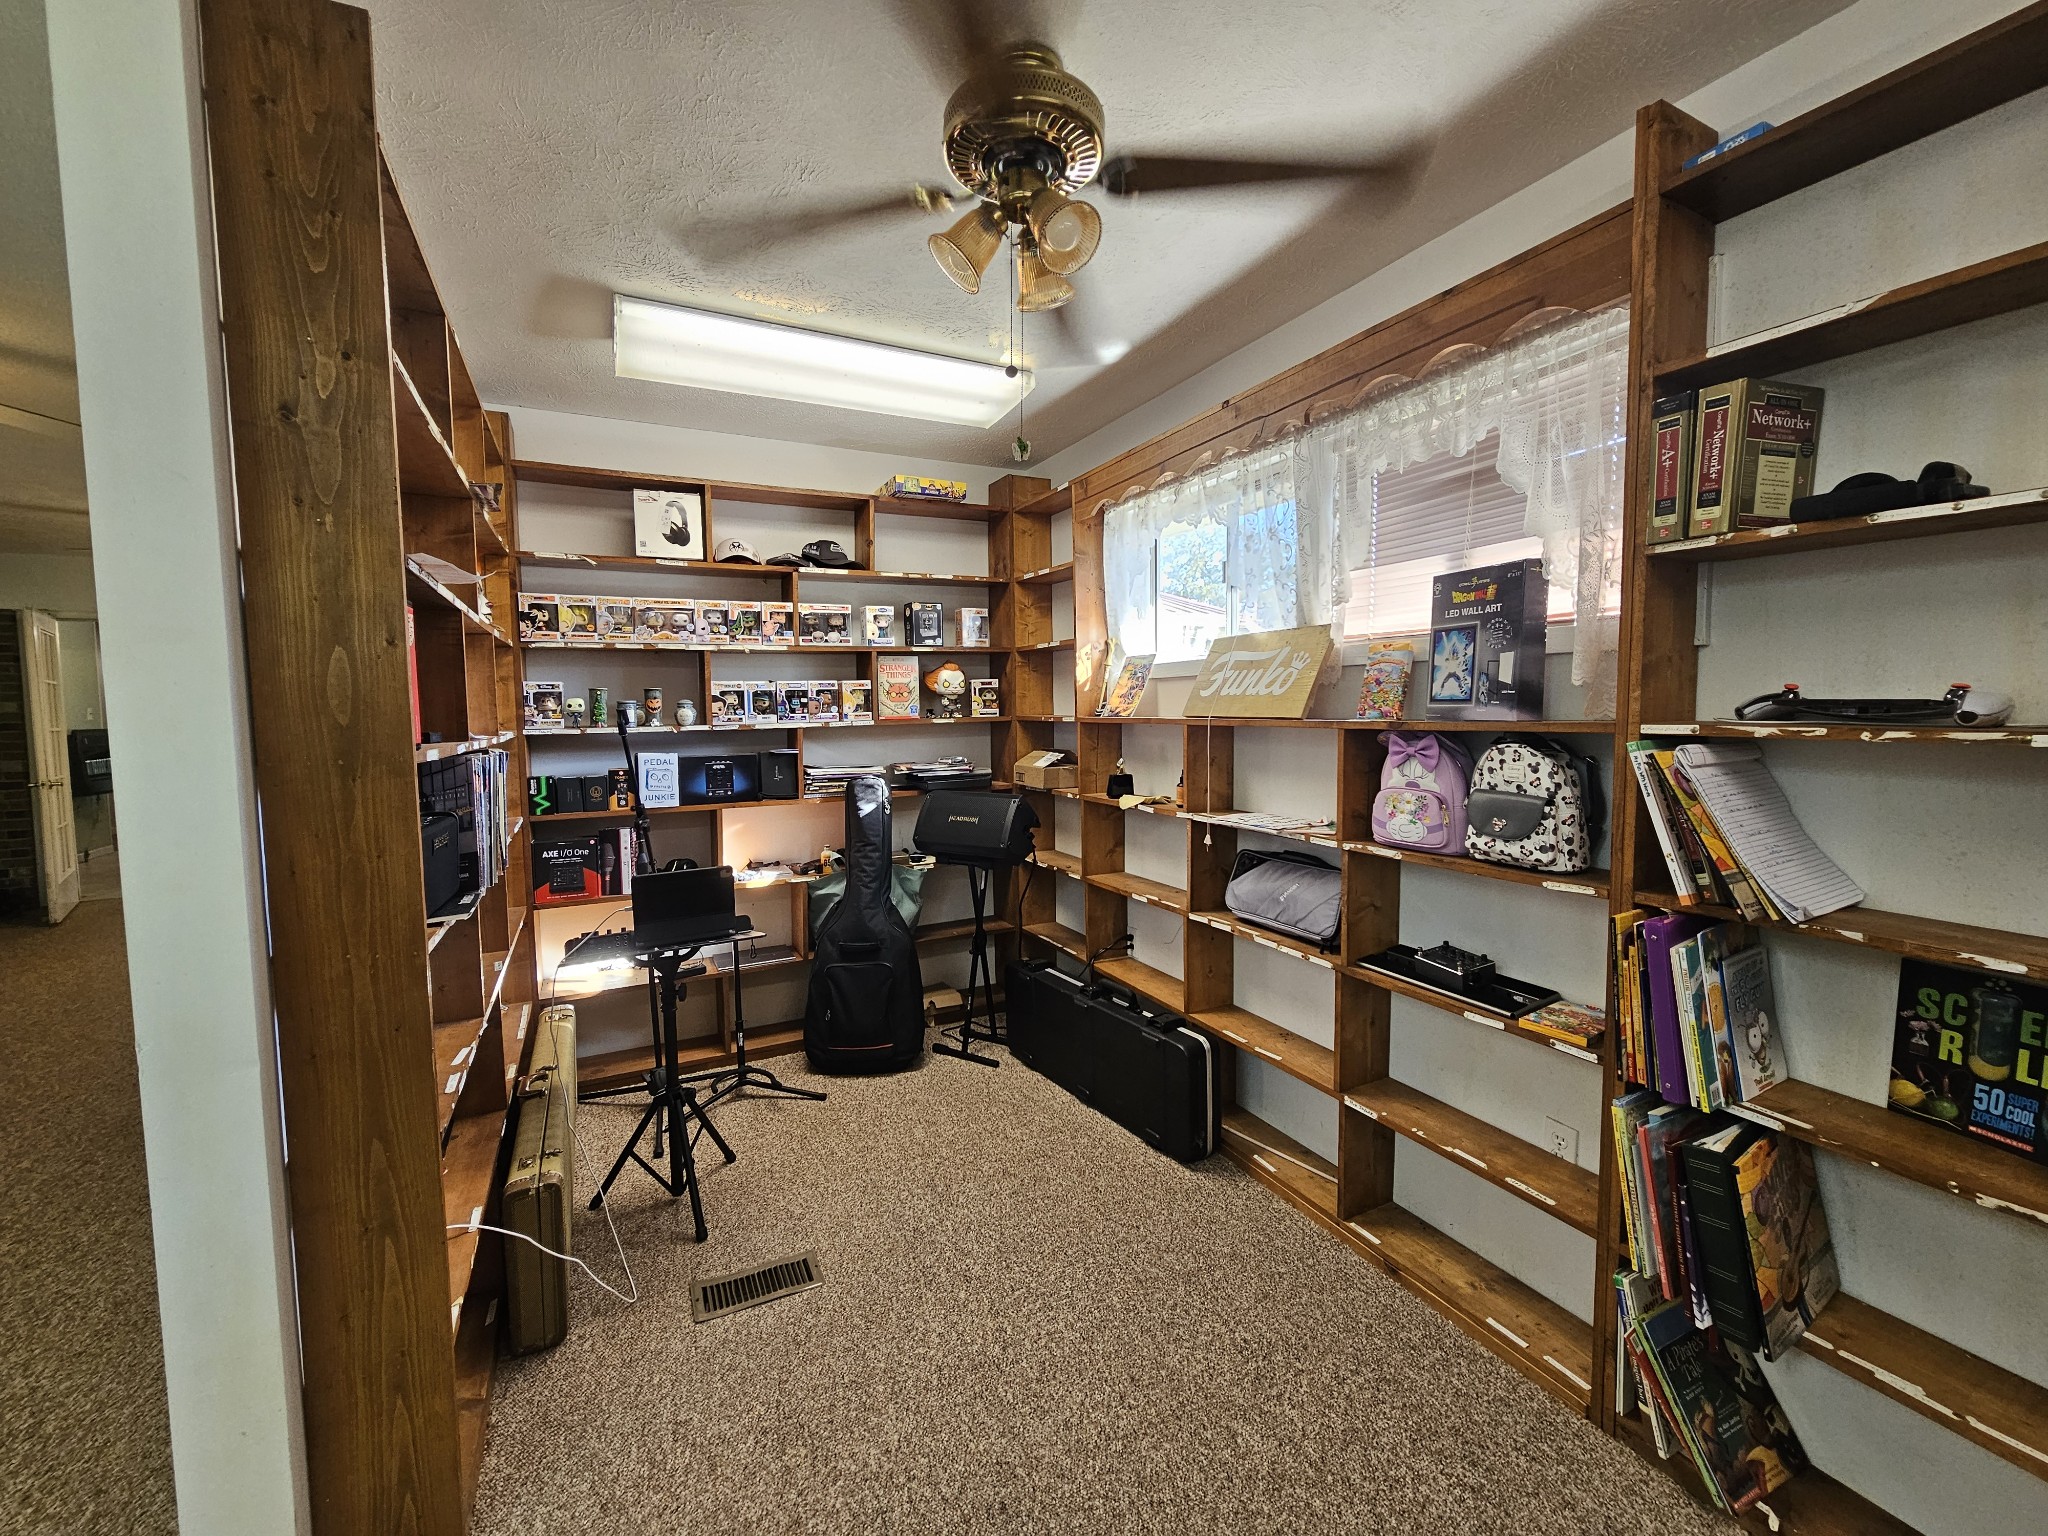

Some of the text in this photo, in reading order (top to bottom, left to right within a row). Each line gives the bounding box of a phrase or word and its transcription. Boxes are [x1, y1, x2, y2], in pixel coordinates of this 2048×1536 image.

[1751, 407, 1812, 430] Network+
[1661, 448, 1676, 468] A+
[1708, 428, 1725, 480] Network+
[1445, 603, 1503, 618] LED WALL ART
[879, 663, 916, 673] STRANGER
[884, 671, 912, 679] THINGS
[1200, 646, 1303, 697] Funko
[643, 758, 674, 766] PEDAL
[644, 793, 676, 802] JUNKIE
[542, 848, 590, 859] AXE I/O One
[1973, 1083, 2006, 1116] 50
[2008, 1092, 2039, 1112] SUPER
[1970, 1109, 2035, 1140] EXPERIMENTS!
[2005, 1105, 2036, 1128] COOL
[1671, 1335, 1705, 1367] Pirate's
